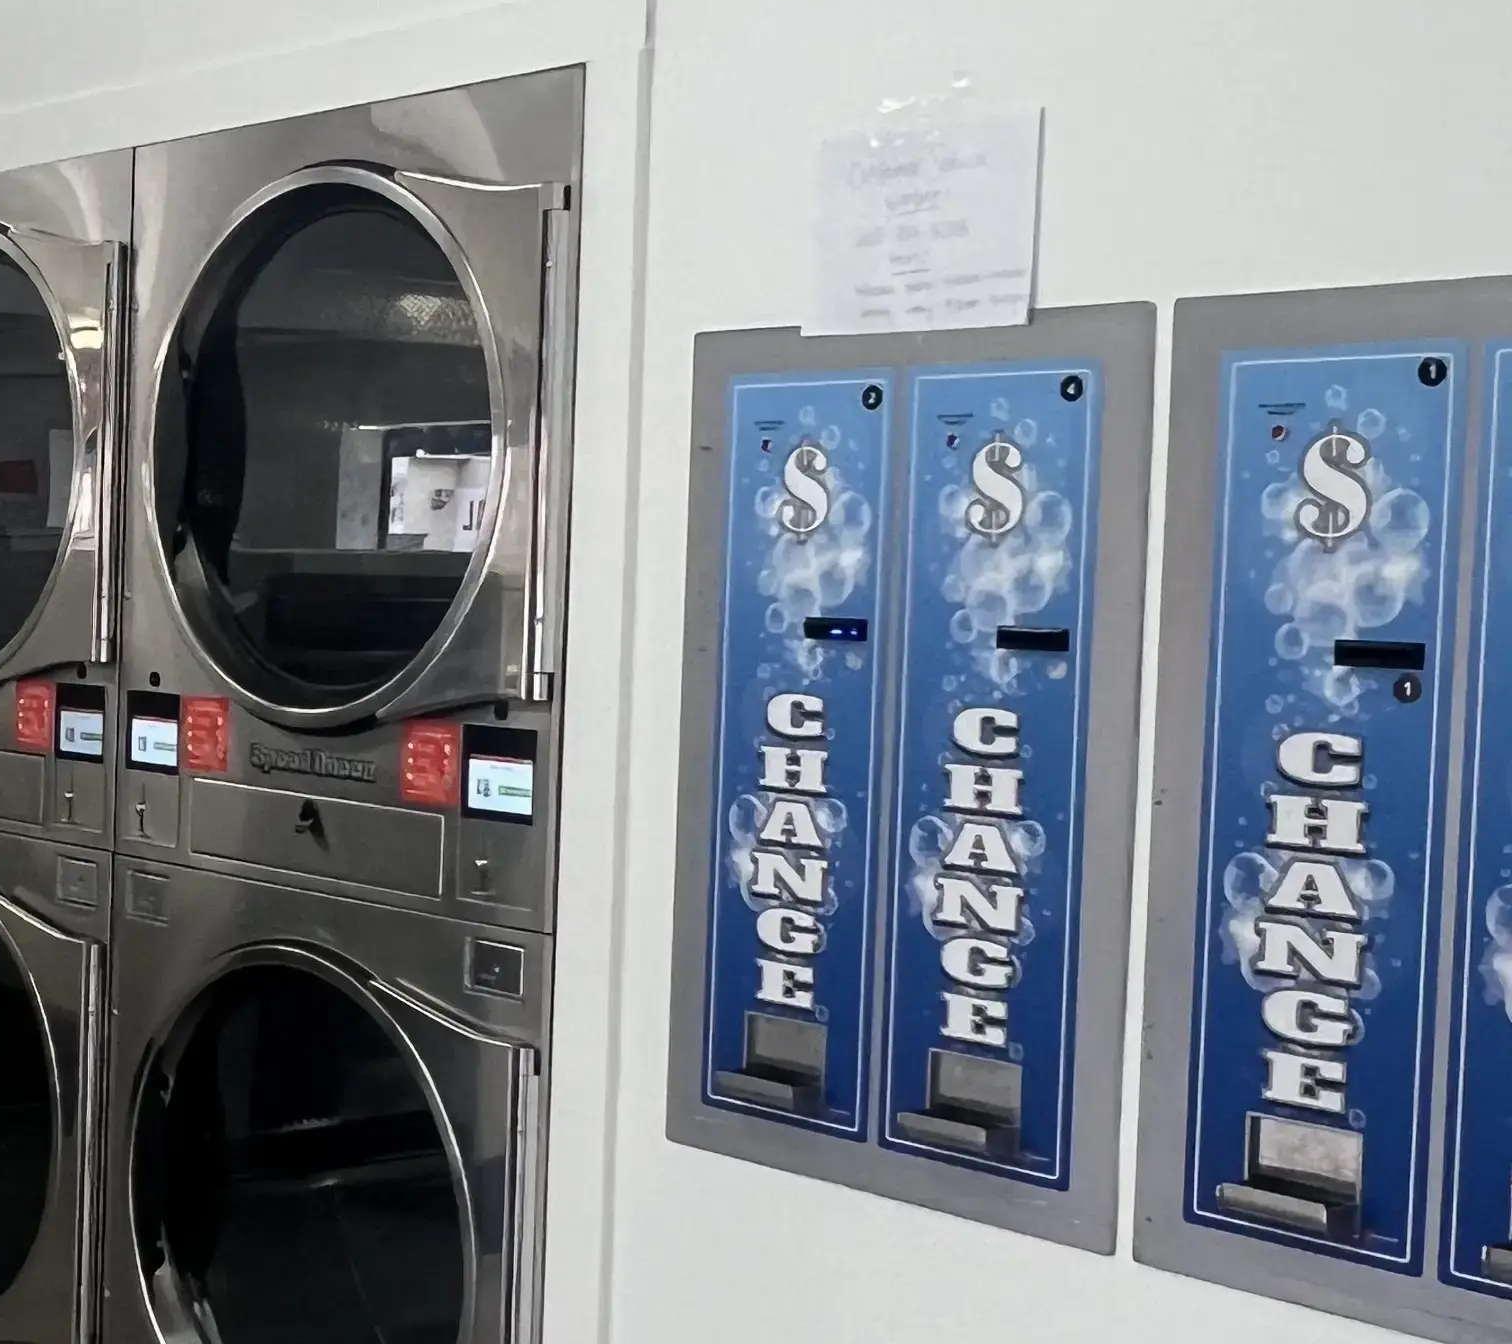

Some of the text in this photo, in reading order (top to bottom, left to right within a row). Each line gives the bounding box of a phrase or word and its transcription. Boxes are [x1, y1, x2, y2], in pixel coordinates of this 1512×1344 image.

[968, 432, 1023, 543] $
[1298, 424, 1369, 548] $
[1403, 681, 1412, 697] 1
[751, 693, 828, 1010] CHANGE
[933, 708, 1024, 1048] CHANGE
[1255, 732, 1368, 1113] CHANGE
